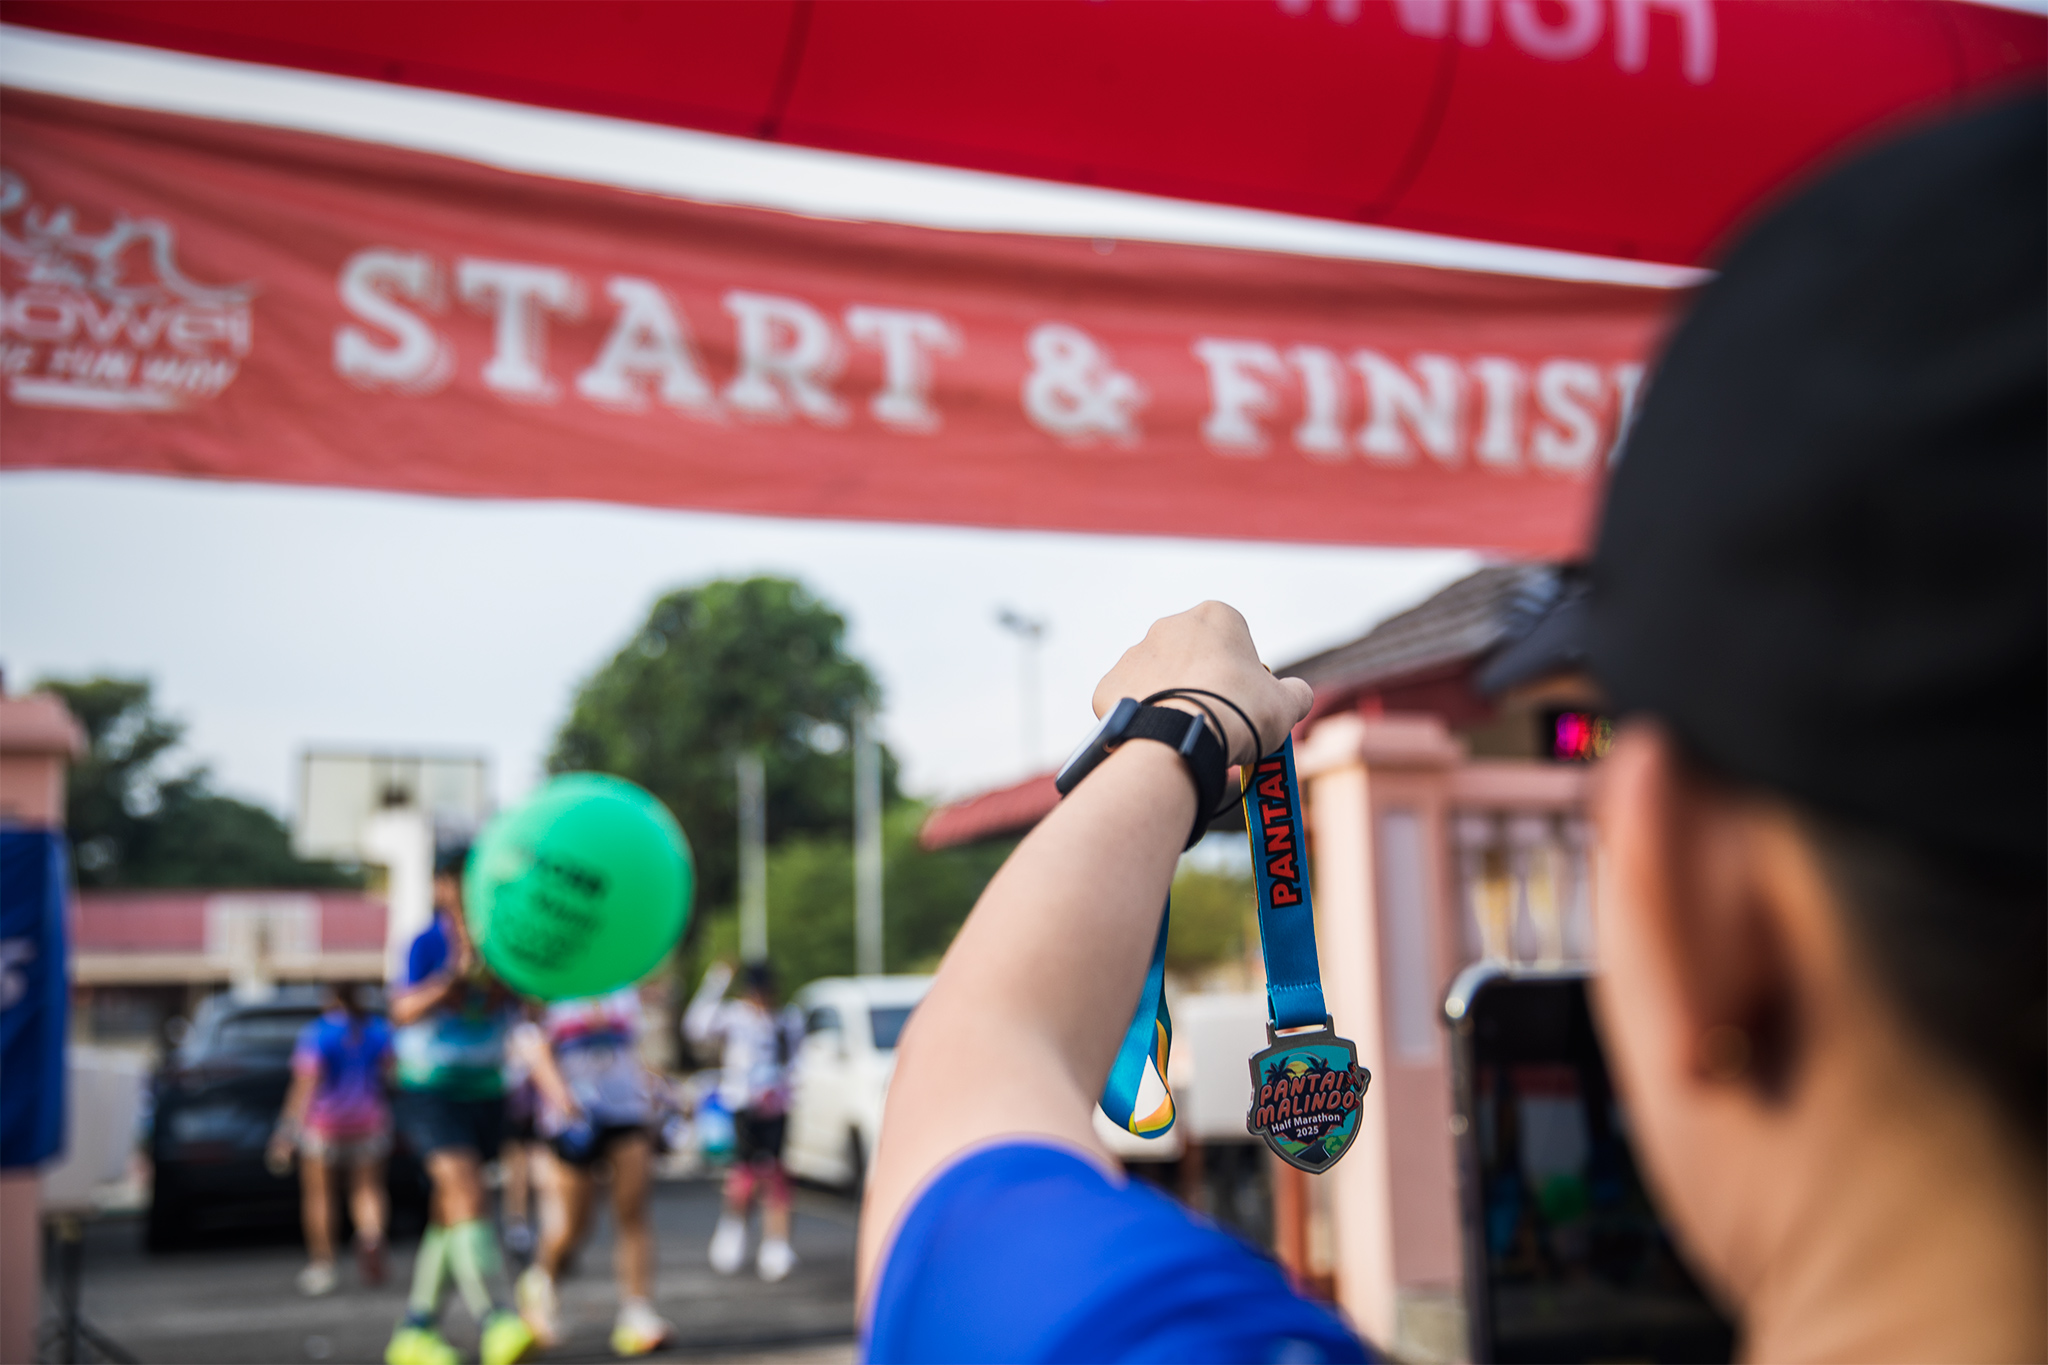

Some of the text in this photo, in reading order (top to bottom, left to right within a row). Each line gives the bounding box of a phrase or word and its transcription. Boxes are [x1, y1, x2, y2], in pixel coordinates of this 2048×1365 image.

[333, 247, 1645, 477] START & FINIS
[1256, 757, 1302, 908] PANTAI
[1259, 1070, 1345, 1107] PANTAI
[1255, 1090, 1357, 1129] MALINDO
[1271, 1112, 1341, 1134] Half Marathon
[1296, 1125, 1319, 1138] 2025
